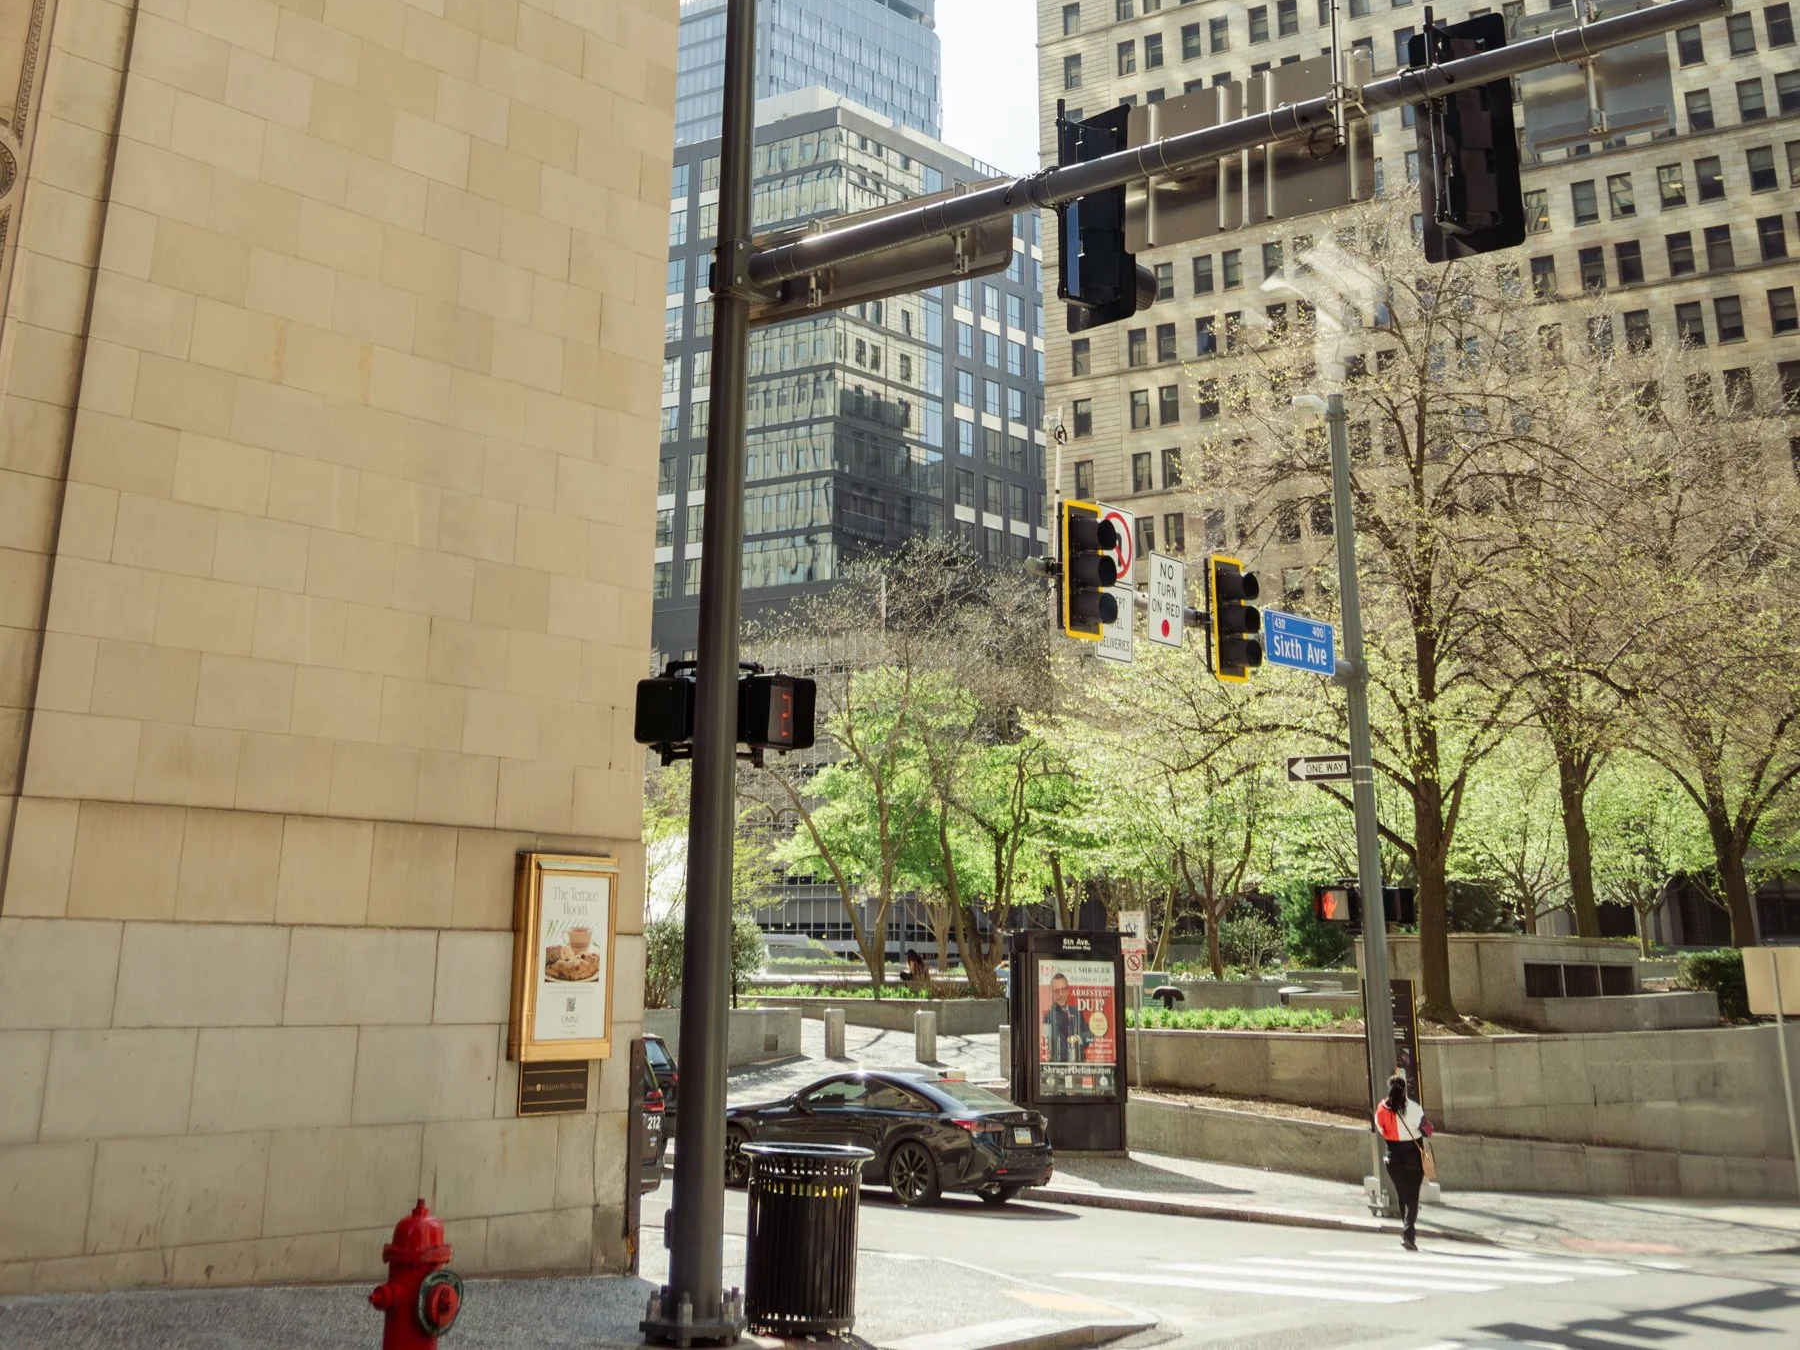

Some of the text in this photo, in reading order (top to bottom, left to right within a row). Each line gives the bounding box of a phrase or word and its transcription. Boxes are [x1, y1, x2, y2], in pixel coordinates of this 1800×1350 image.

[1160, 562, 1174, 580] NO
[1157, 581, 1177, 599] TURN
[1151, 598, 1180, 618] ON RED
[1274, 617, 1324, 639] 430 400
[1273, 634, 1327, 666] Sixth Ave
[1305, 762, 1344, 774] ONE WAY
[552, 886, 599, 902] The Terrace
[562, 901, 588, 916] Room
[1062, 938, 1074, 946] 6th
[1078, 966, 1111, 974] SHRAGER
[1071, 989, 1111, 997] ARRESTED?
[1077, 998, 1105, 1012] DUI?
[647, 1115, 661, 1130] 212
